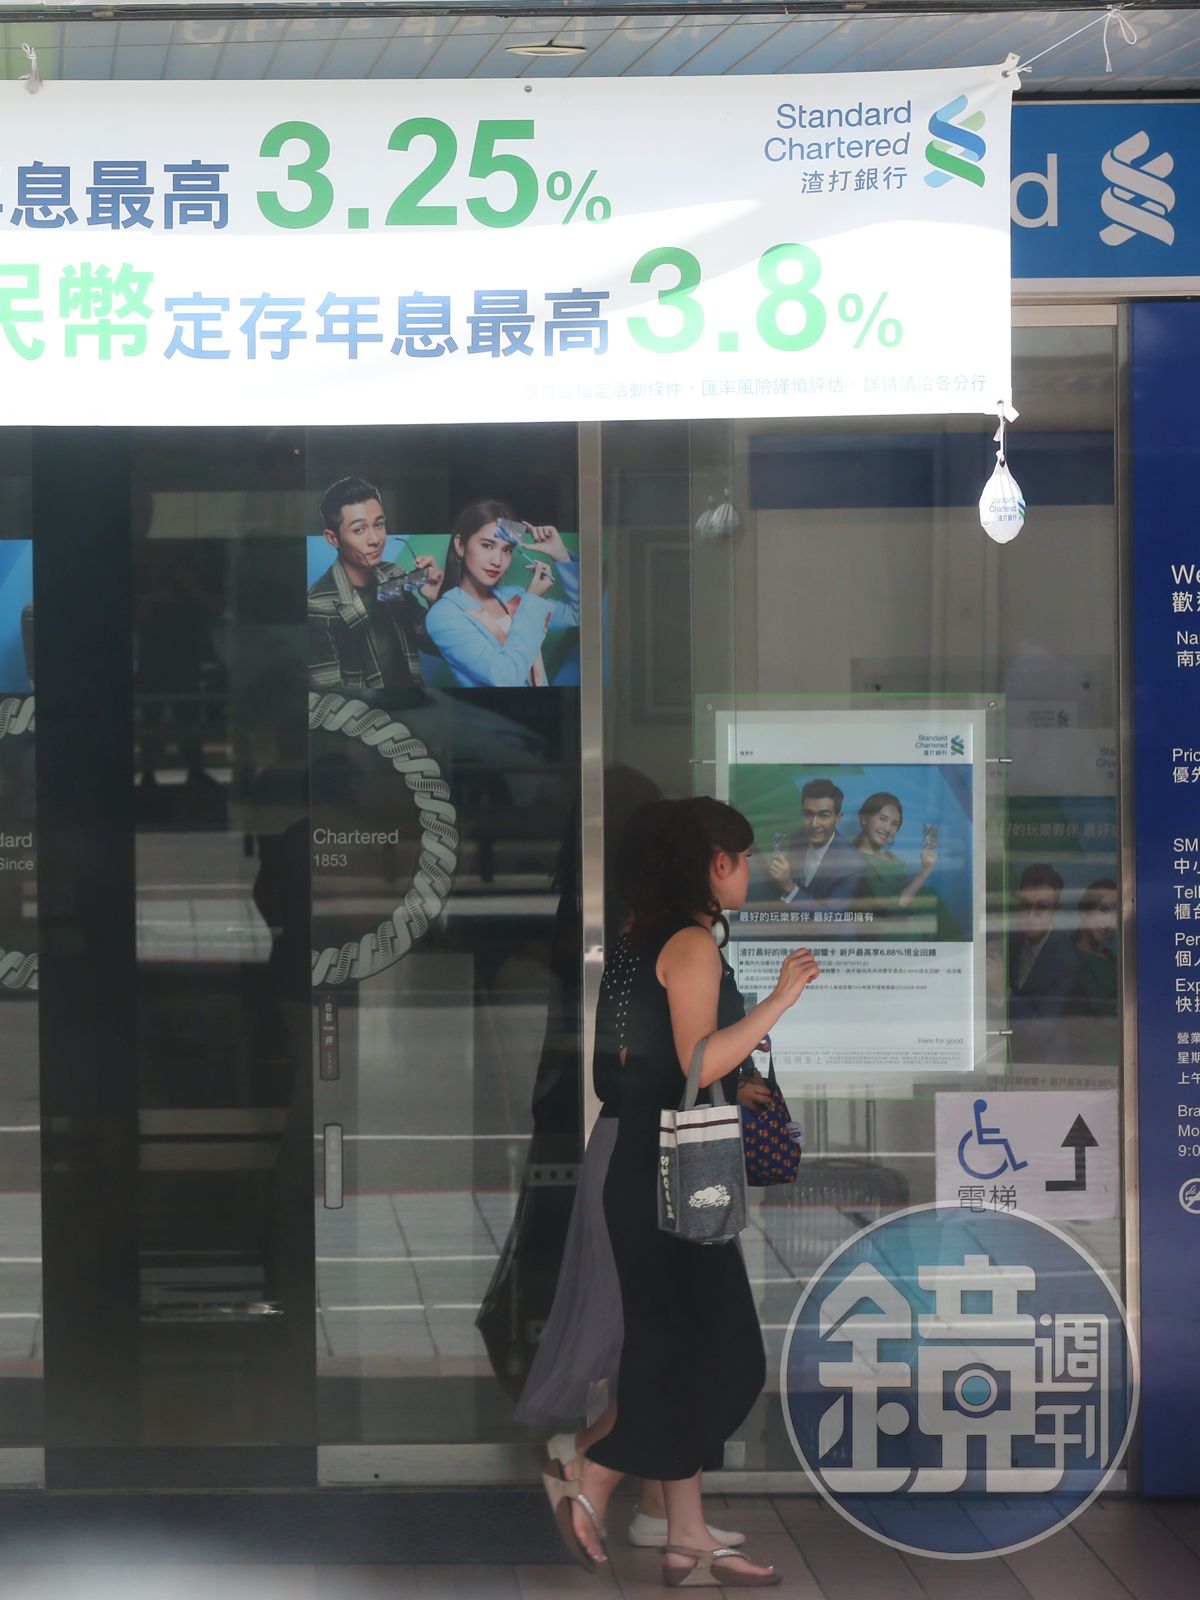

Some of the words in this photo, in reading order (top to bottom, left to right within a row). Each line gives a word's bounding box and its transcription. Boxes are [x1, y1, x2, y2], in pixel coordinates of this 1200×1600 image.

[776, 100, 912, 129] Standard
[764, 132, 910, 162] Chartered
[257, 116, 612, 229] 3.25%
[801, 165, 908, 194] 渣打銀行
[627, 242, 904, 353] 3.8%
[313, 828, 399, 845] Chartered
[313, 853, 348, 868] 1853
[958, 1184, 1017, 1213] 電梯
